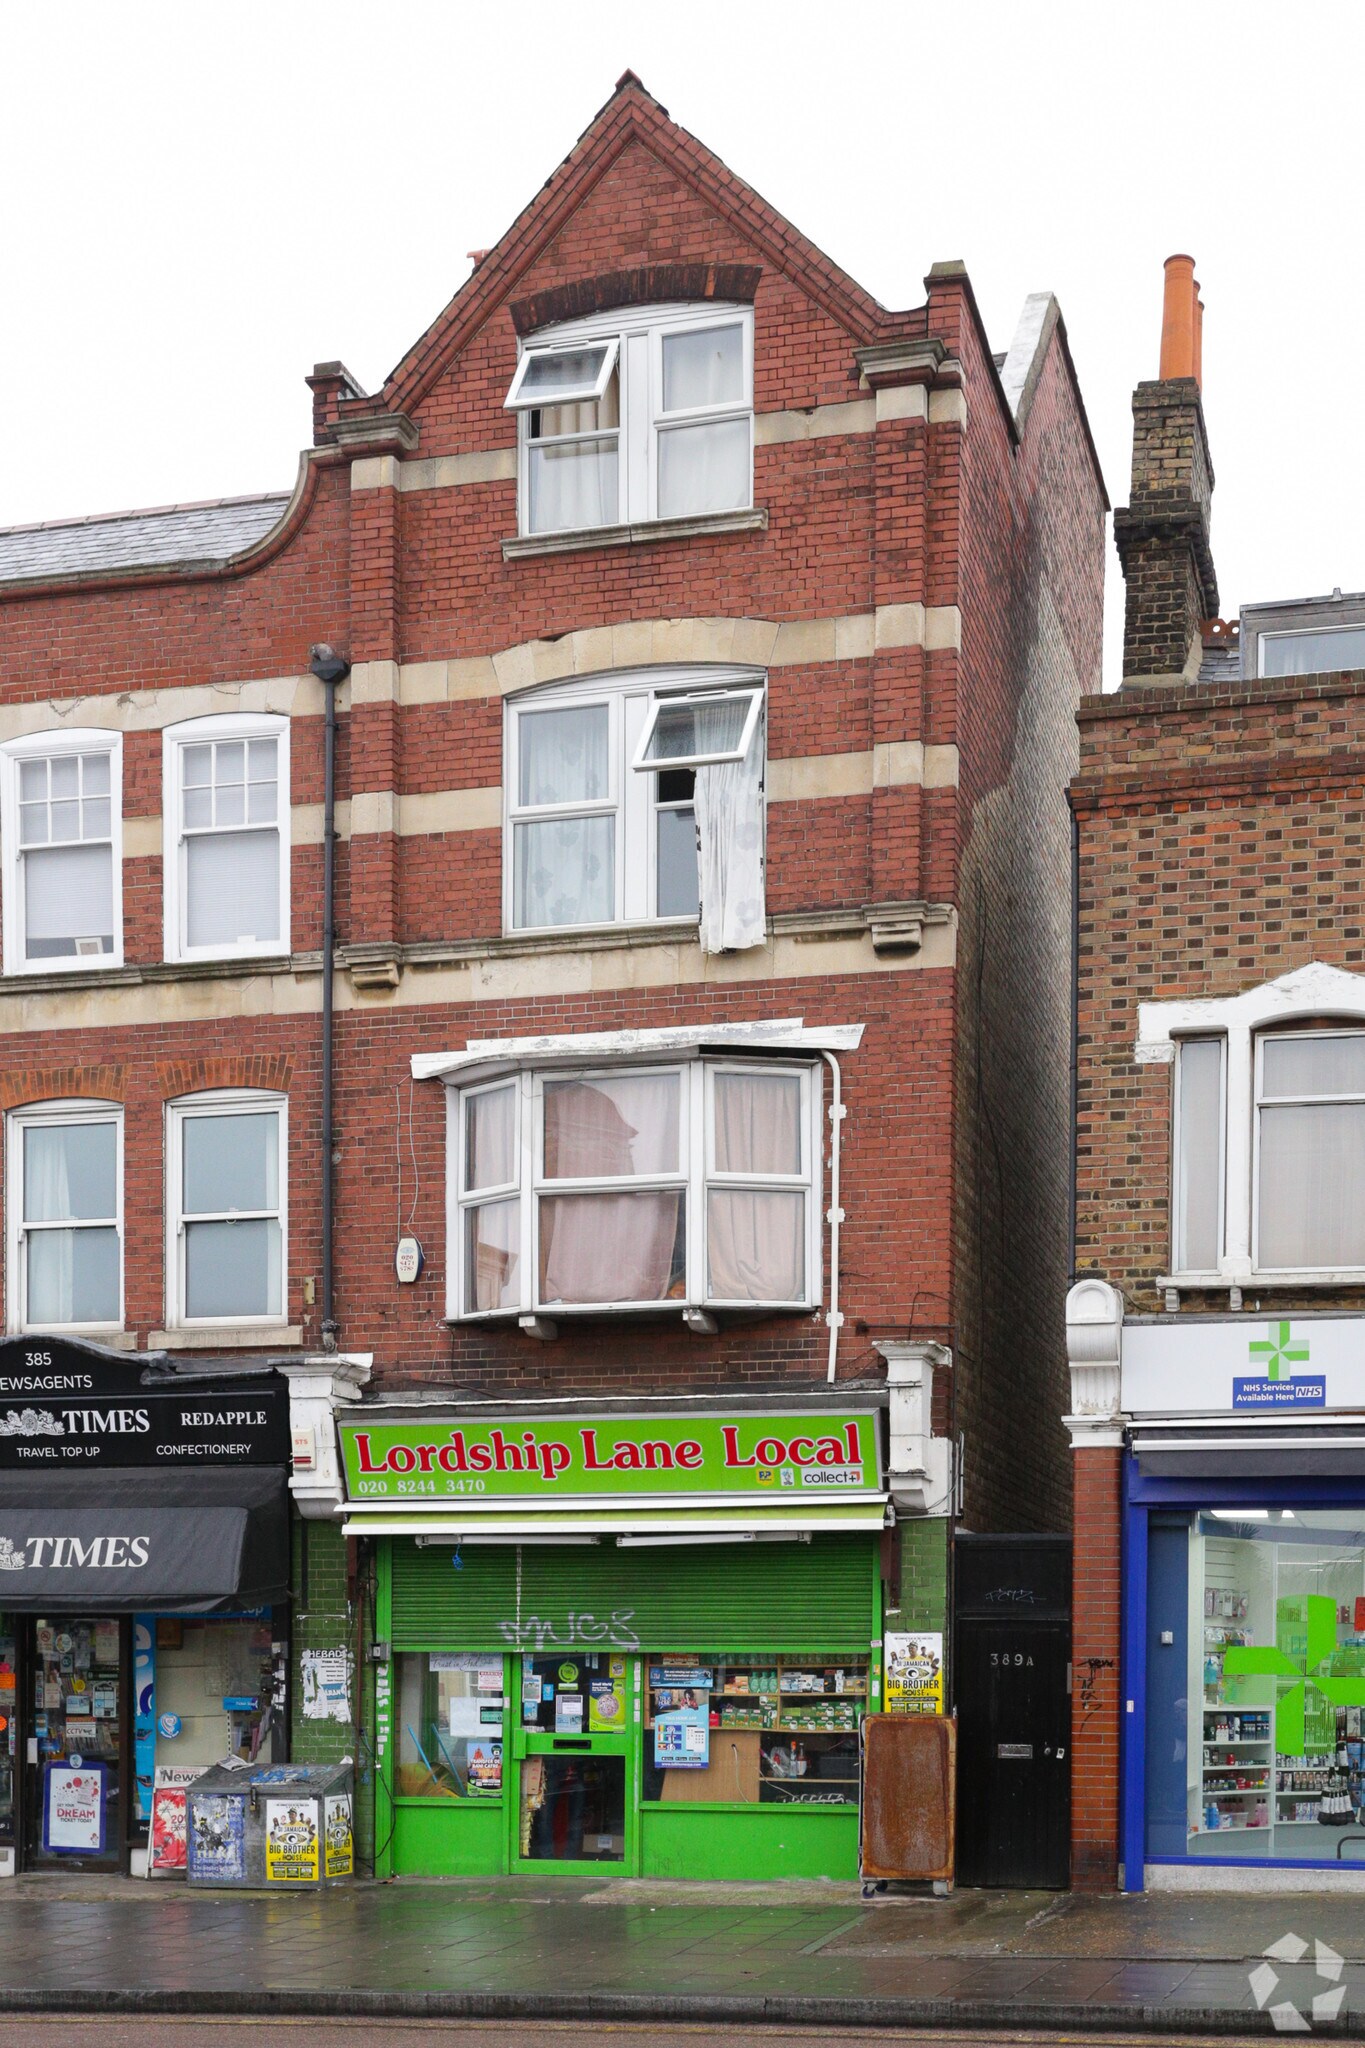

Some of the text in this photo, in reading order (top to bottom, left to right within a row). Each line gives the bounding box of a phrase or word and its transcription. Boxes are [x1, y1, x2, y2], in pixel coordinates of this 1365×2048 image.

[25, 1352, 52, 1366] 385
[1262, 1383, 1295, 1391] Services
[1296, 1387, 1321, 1396] NHS
[1236, 1393, 1295, 1402] Available Here
[62, 1409, 150, 1434] TIMES
[17, 1446, 100, 1457] TRAVEL TOP UP
[156, 1444, 252, 1456] CONFECTIONERY
[354, 1421, 864, 1480] Lordship Lane Local
[358, 1479, 485, 1493] 020 8244 3470
[26, 1536, 150, 1568] TIMES
[887, 1680, 939, 1689] BIG BROTHER
[66, 1725, 82, 1734] CCTV
[57, 1808, 96, 1818] DREAM
[269, 1845, 315, 1854] BIG BROTHER
